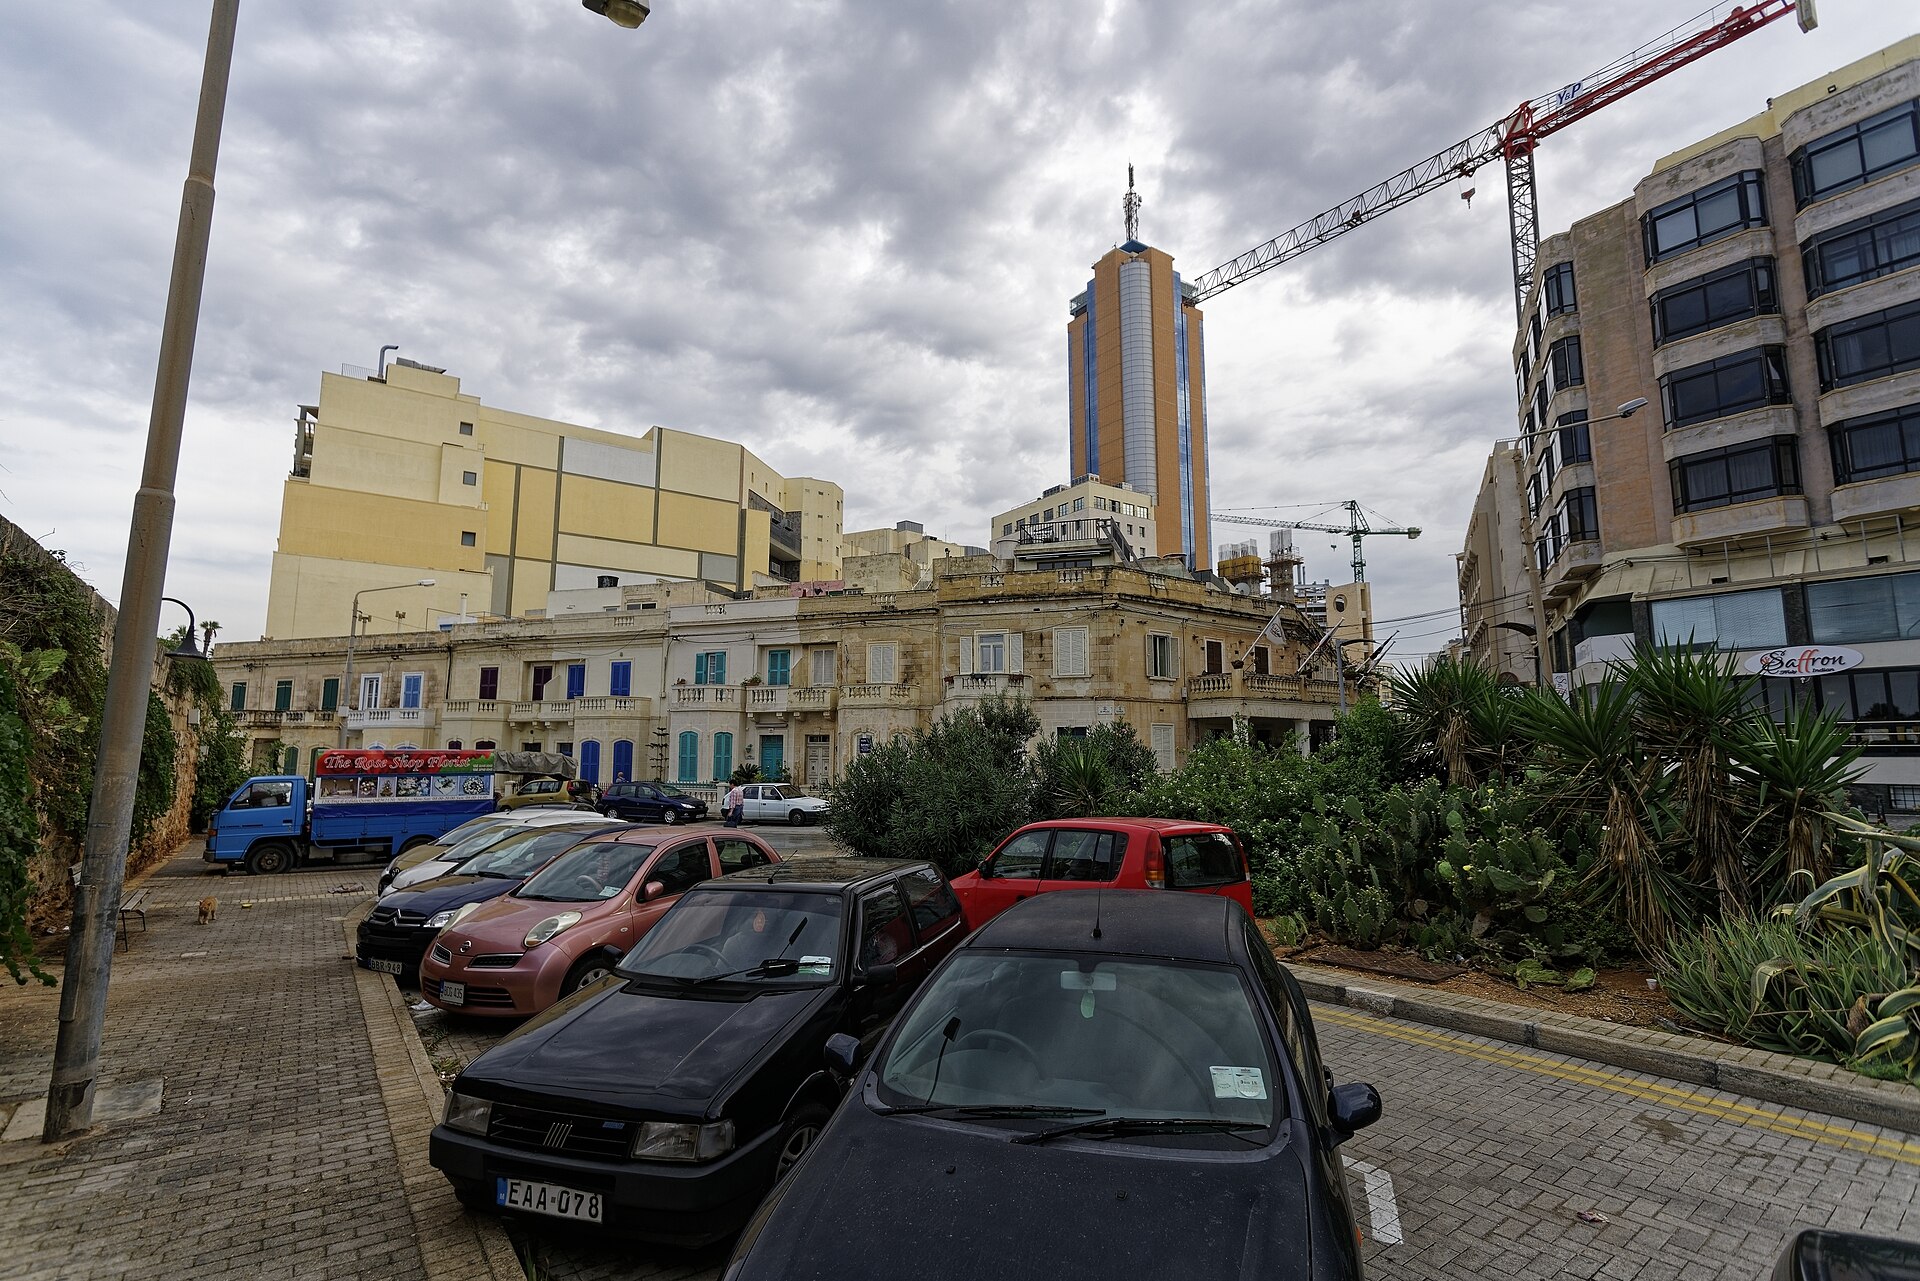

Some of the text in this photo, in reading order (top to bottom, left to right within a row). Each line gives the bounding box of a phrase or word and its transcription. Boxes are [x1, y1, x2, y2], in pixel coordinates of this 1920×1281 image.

[1558, 83, 1581, 104] Y&P
[1760, 648, 1846, 675] Saffron
[324, 755, 351, 769] The
[354, 756, 388, 771] Rose
[389, 753, 425, 772] Shop
[427, 754, 471, 768] Florist
